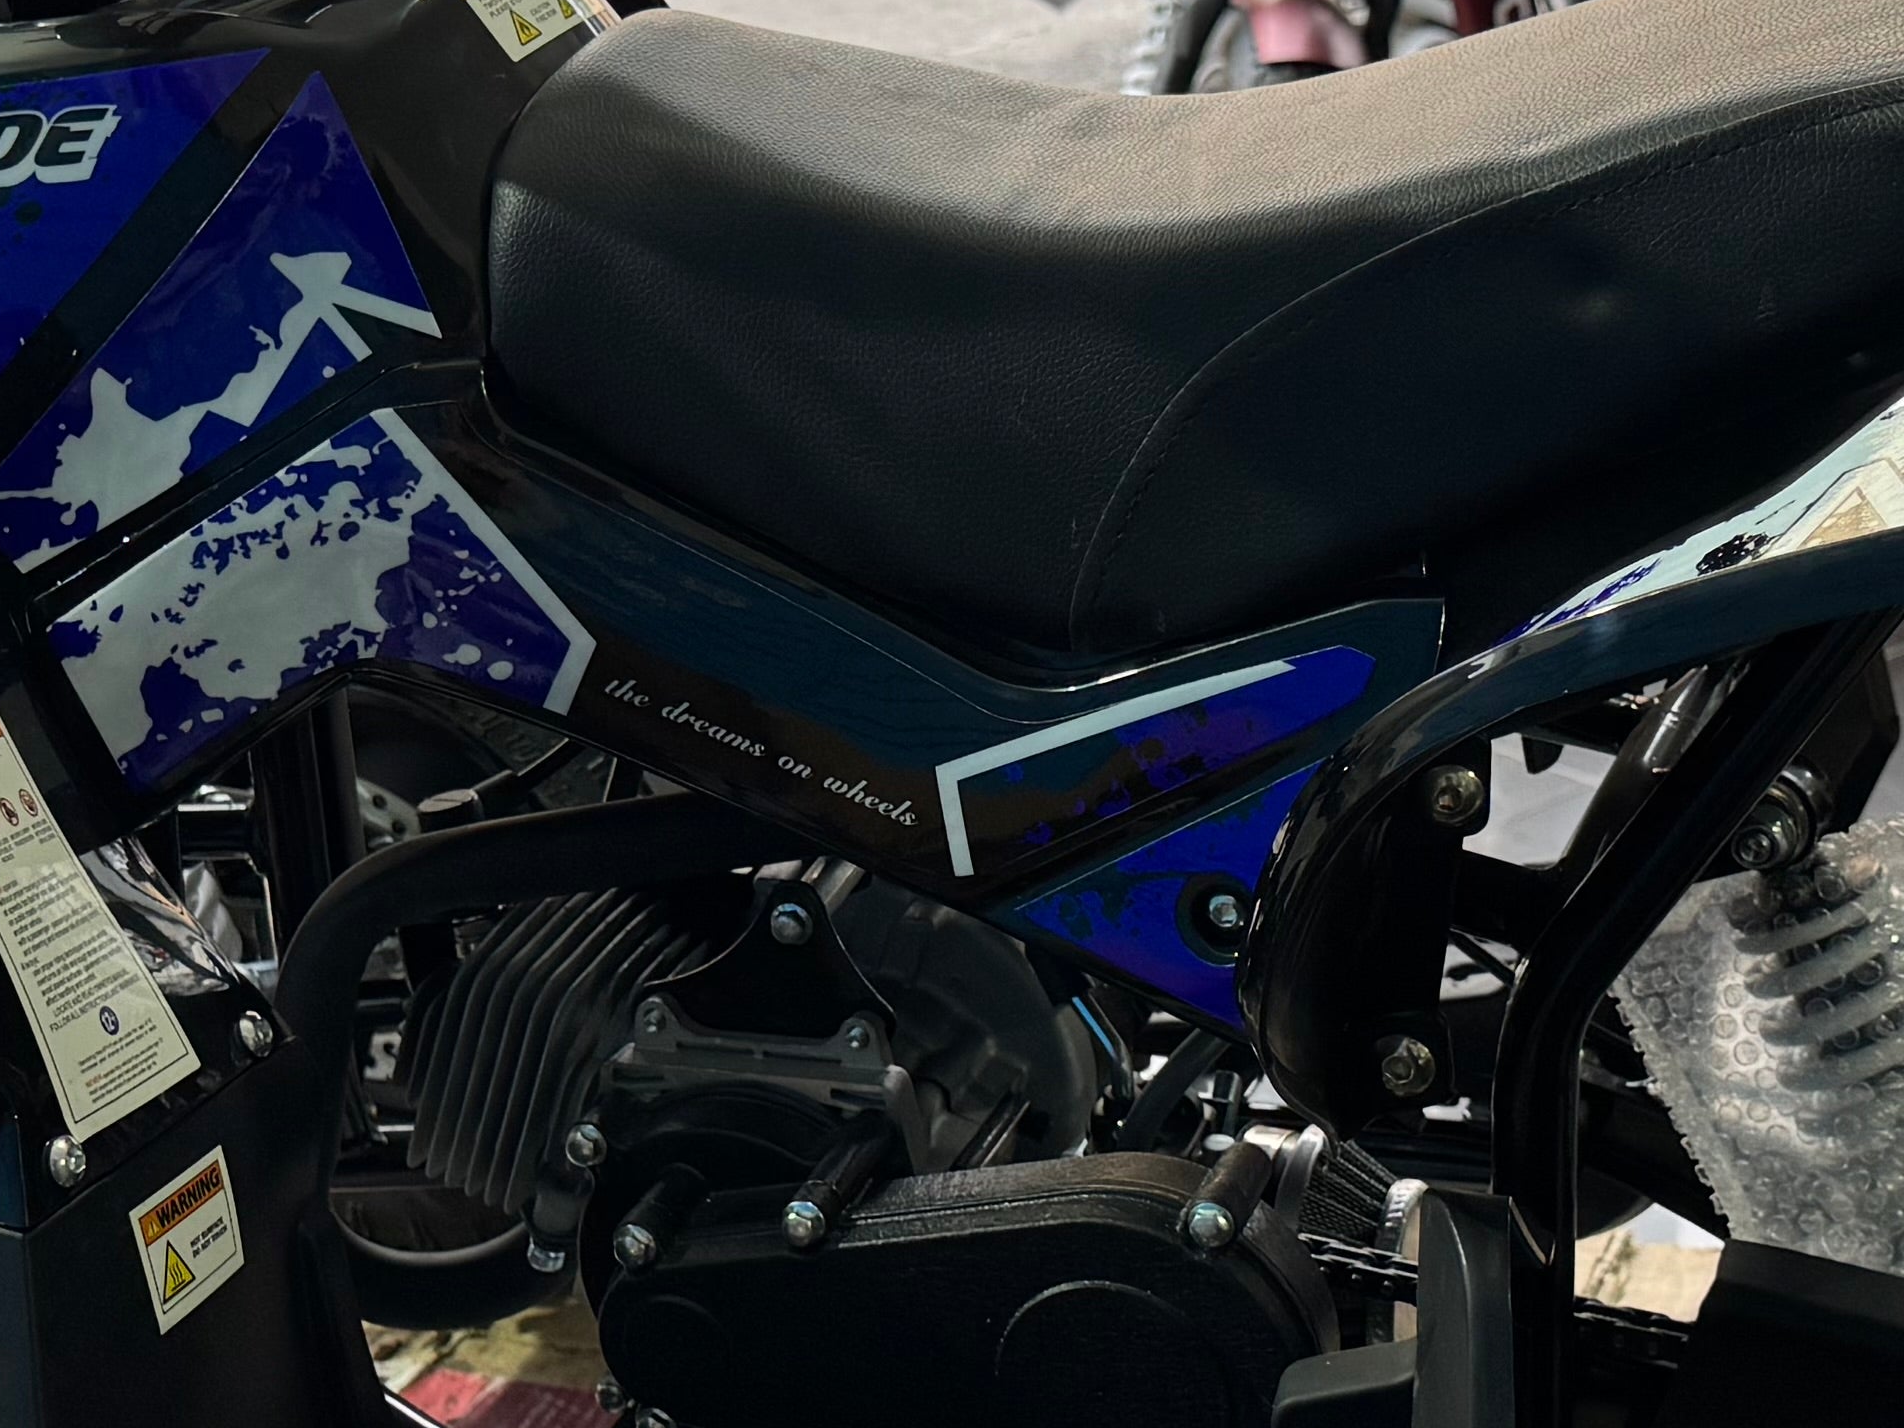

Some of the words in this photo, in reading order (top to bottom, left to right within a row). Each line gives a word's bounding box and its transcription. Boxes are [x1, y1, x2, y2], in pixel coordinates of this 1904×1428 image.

[604, 679, 650, 707] the
[661, 702, 766, 757] dreams
[778, 755, 814, 780] on
[823, 780, 919, 826] wheels
[156, 1167, 220, 1228] WARNING
